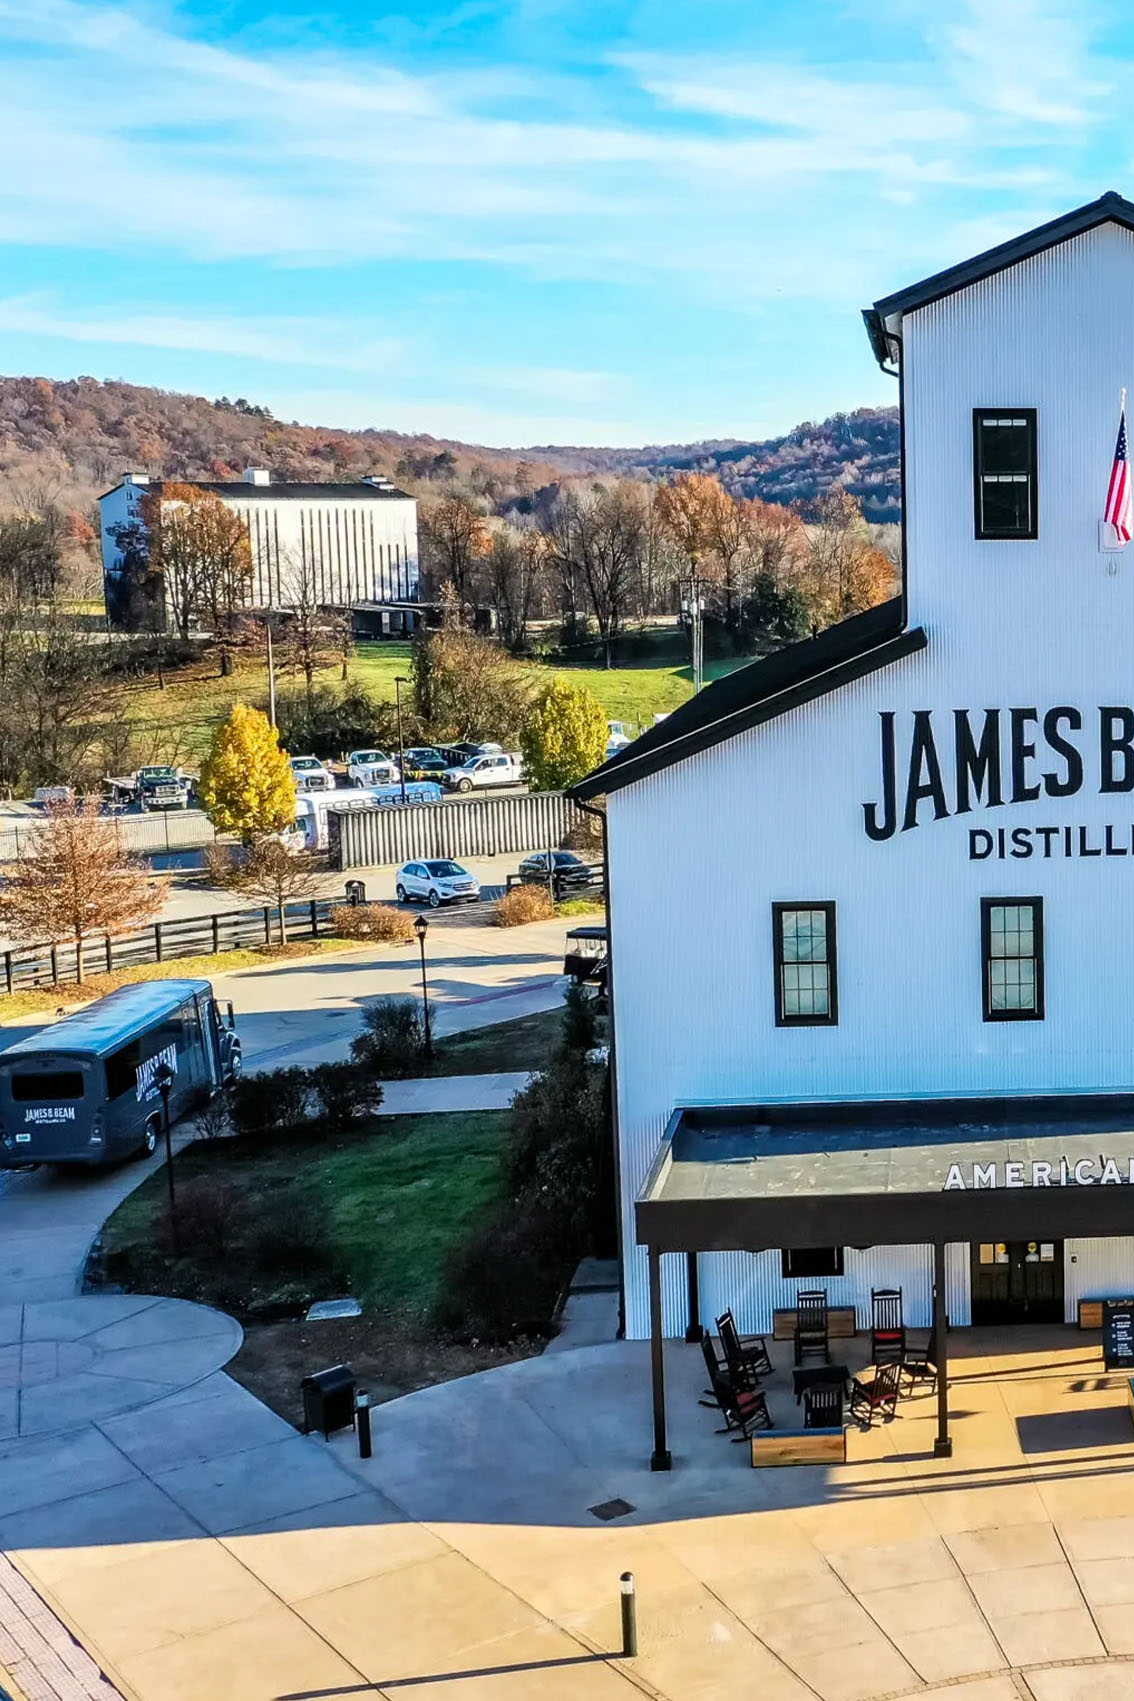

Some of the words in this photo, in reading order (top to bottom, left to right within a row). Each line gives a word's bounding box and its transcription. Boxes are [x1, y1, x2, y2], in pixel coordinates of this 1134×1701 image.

[861, 705, 1084, 842] JAMES
[24, 1108, 48, 1122] JAMES
[54, 1107, 76, 1120] BEAM
